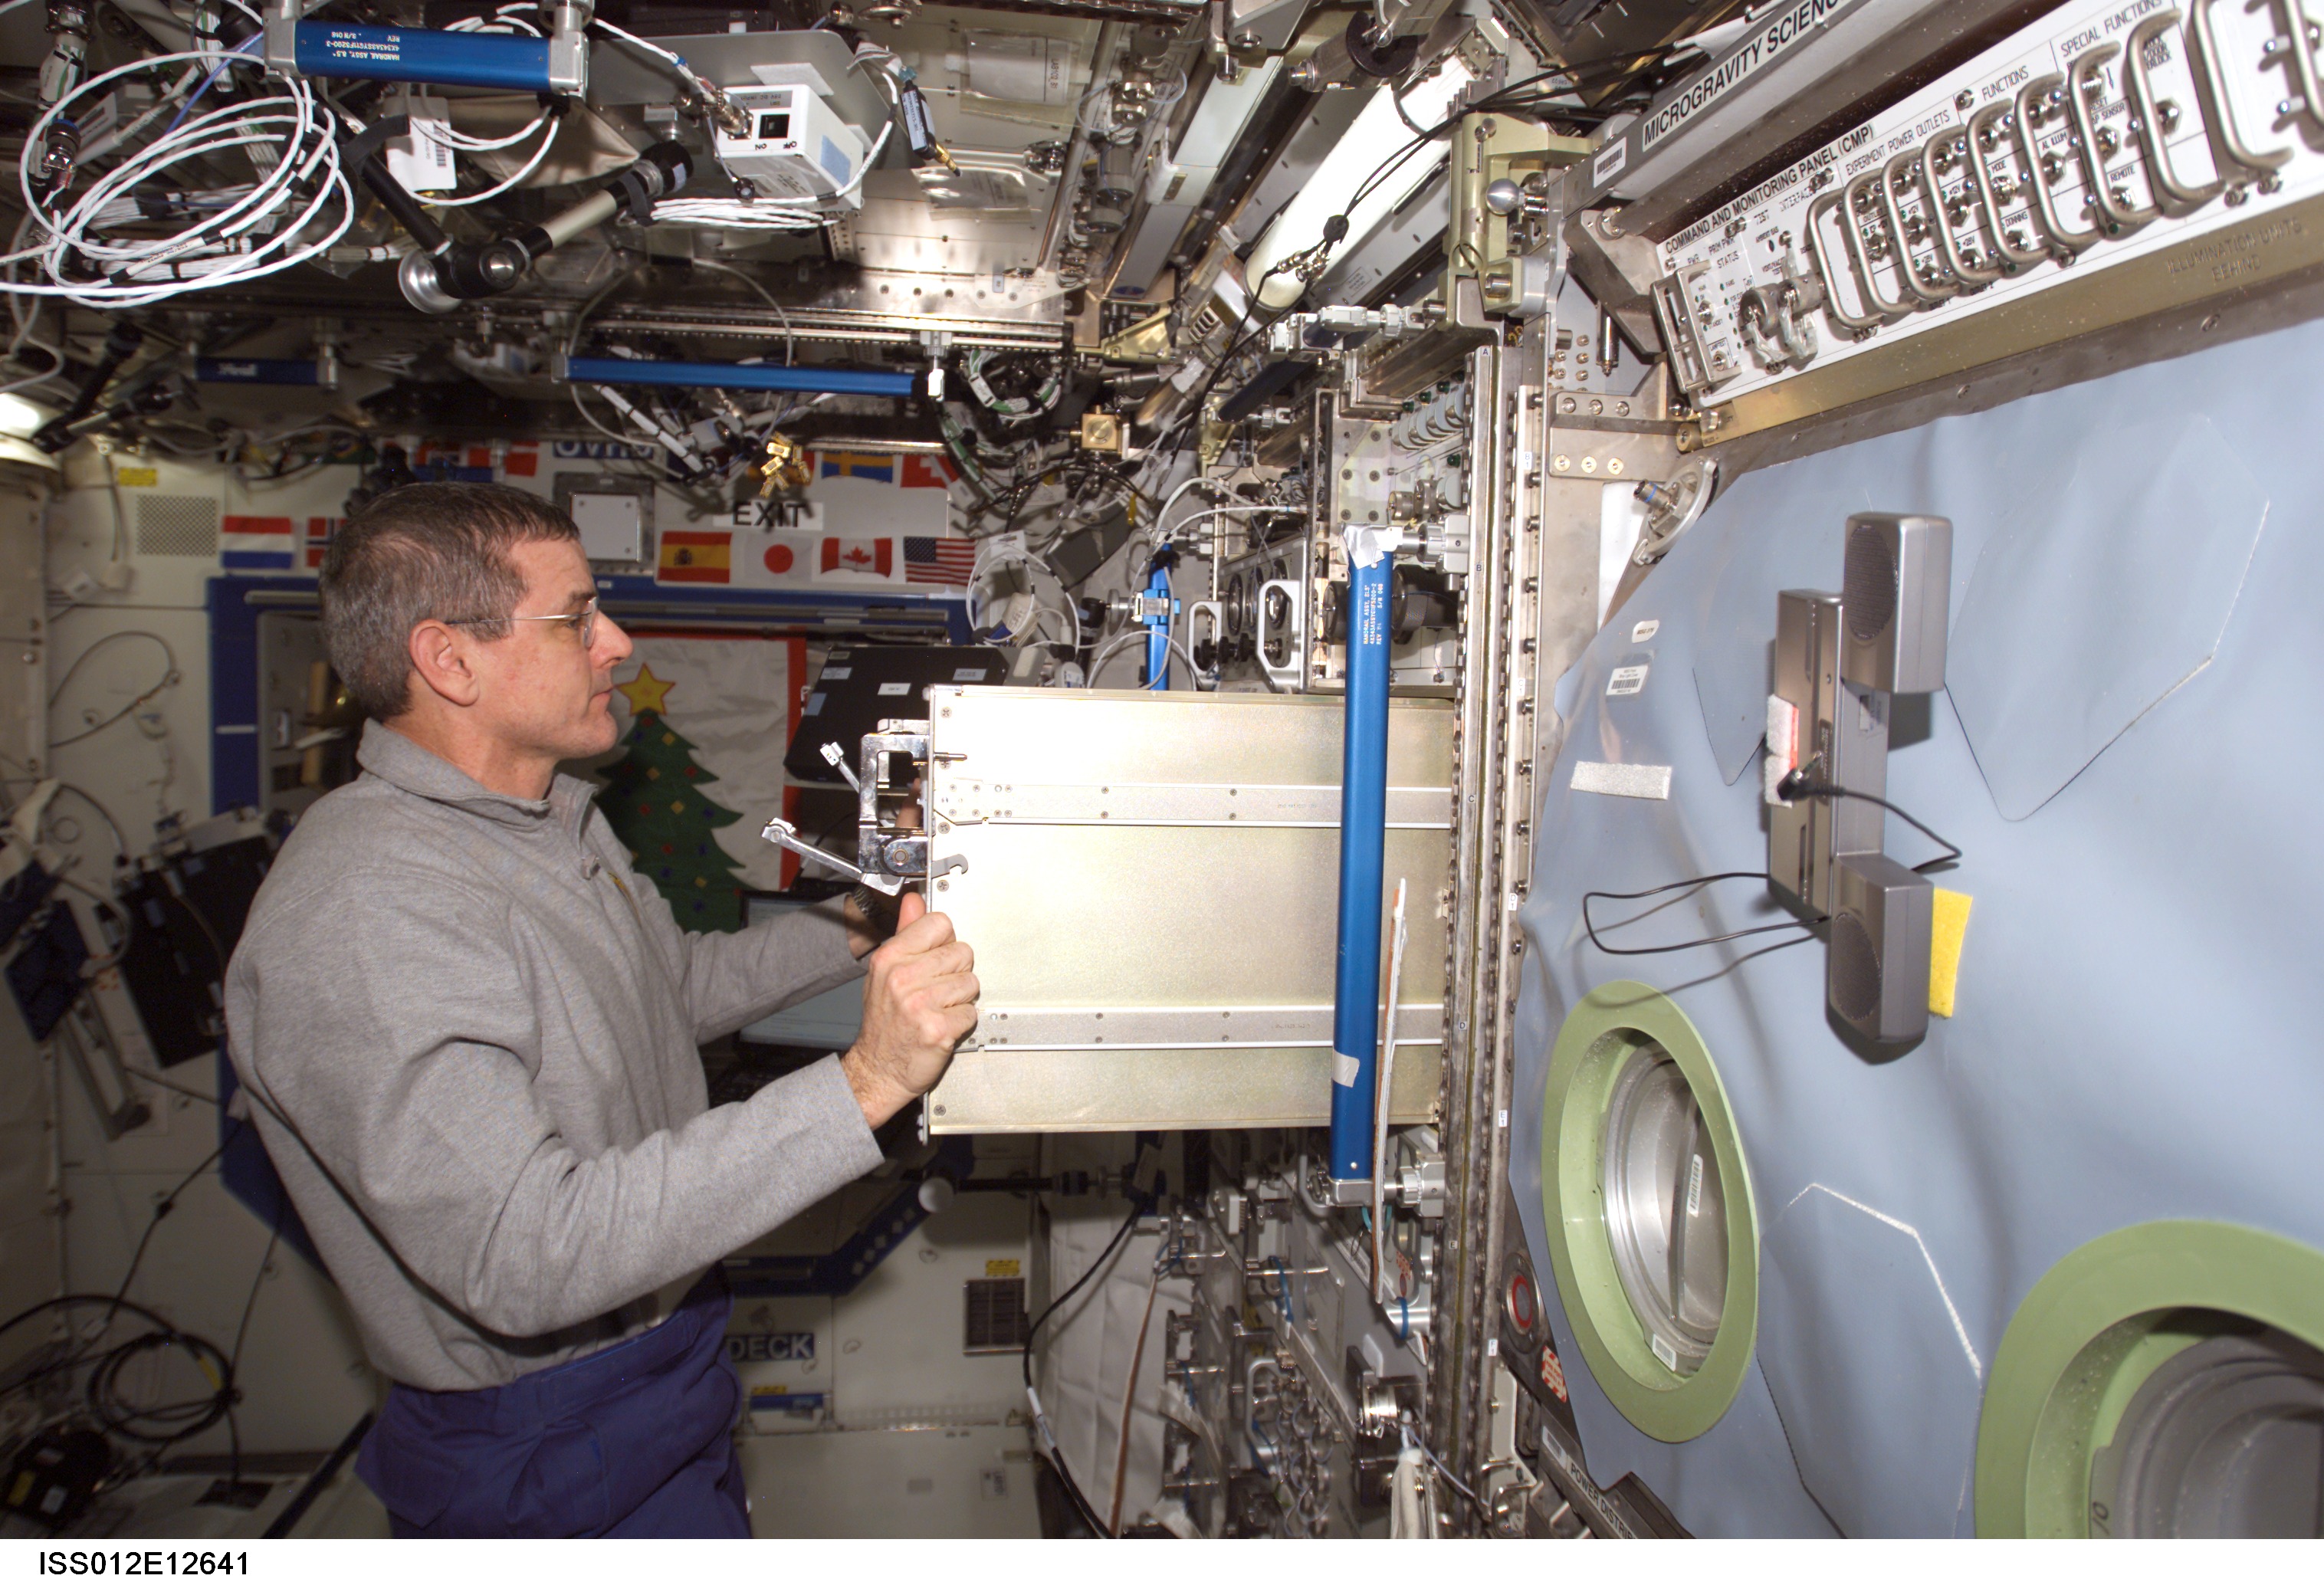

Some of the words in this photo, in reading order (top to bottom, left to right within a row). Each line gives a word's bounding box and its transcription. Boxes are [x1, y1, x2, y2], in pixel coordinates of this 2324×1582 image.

[2061, 27, 2101, 57] SPECIAL
[2104, 0, 2162, 34] FUNCTIONS
[1644, 38, 1762, 146] MICROGRAVITY
[1767, 0, 1837, 54] SCIEN
[1981, 65, 2030, 101] FUNCTIONS
[2101, 102, 2126, 120] SENSOR
[783, 141, 797, 149] OFF
[1846, 147, 1886, 176] EXPERIMENT
[1888, 130, 1914, 153] POWER
[1916, 109, 1950, 137] OUTLETS
[1992, 159, 2007, 173] MODE
[2110, 165, 2135, 183] REMOTE
[1665, 219, 1710, 254] COMMAND
[1712, 206, 1732, 227] AND
[1733, 169, 1798, 217] MONITORING
[1800, 147, 1838, 177] PANEL
[1838, 125, 1875, 159] (CMP)
[1754, 209, 1771, 225] TEST
[2167, 232, 2257, 274] ILLUMINATION
[2259, 217, 2302, 245] UNITS
[1716, 252, 1740, 269] STATUS
[2211, 253, 2262, 282] BEHIND
[732, 501, 805, 527] EXIT
[1475, 563, 1482, 572] B
[727, 1334, 812, 1360] DECK
[1571, 1462, 1600, 1507] POWER
